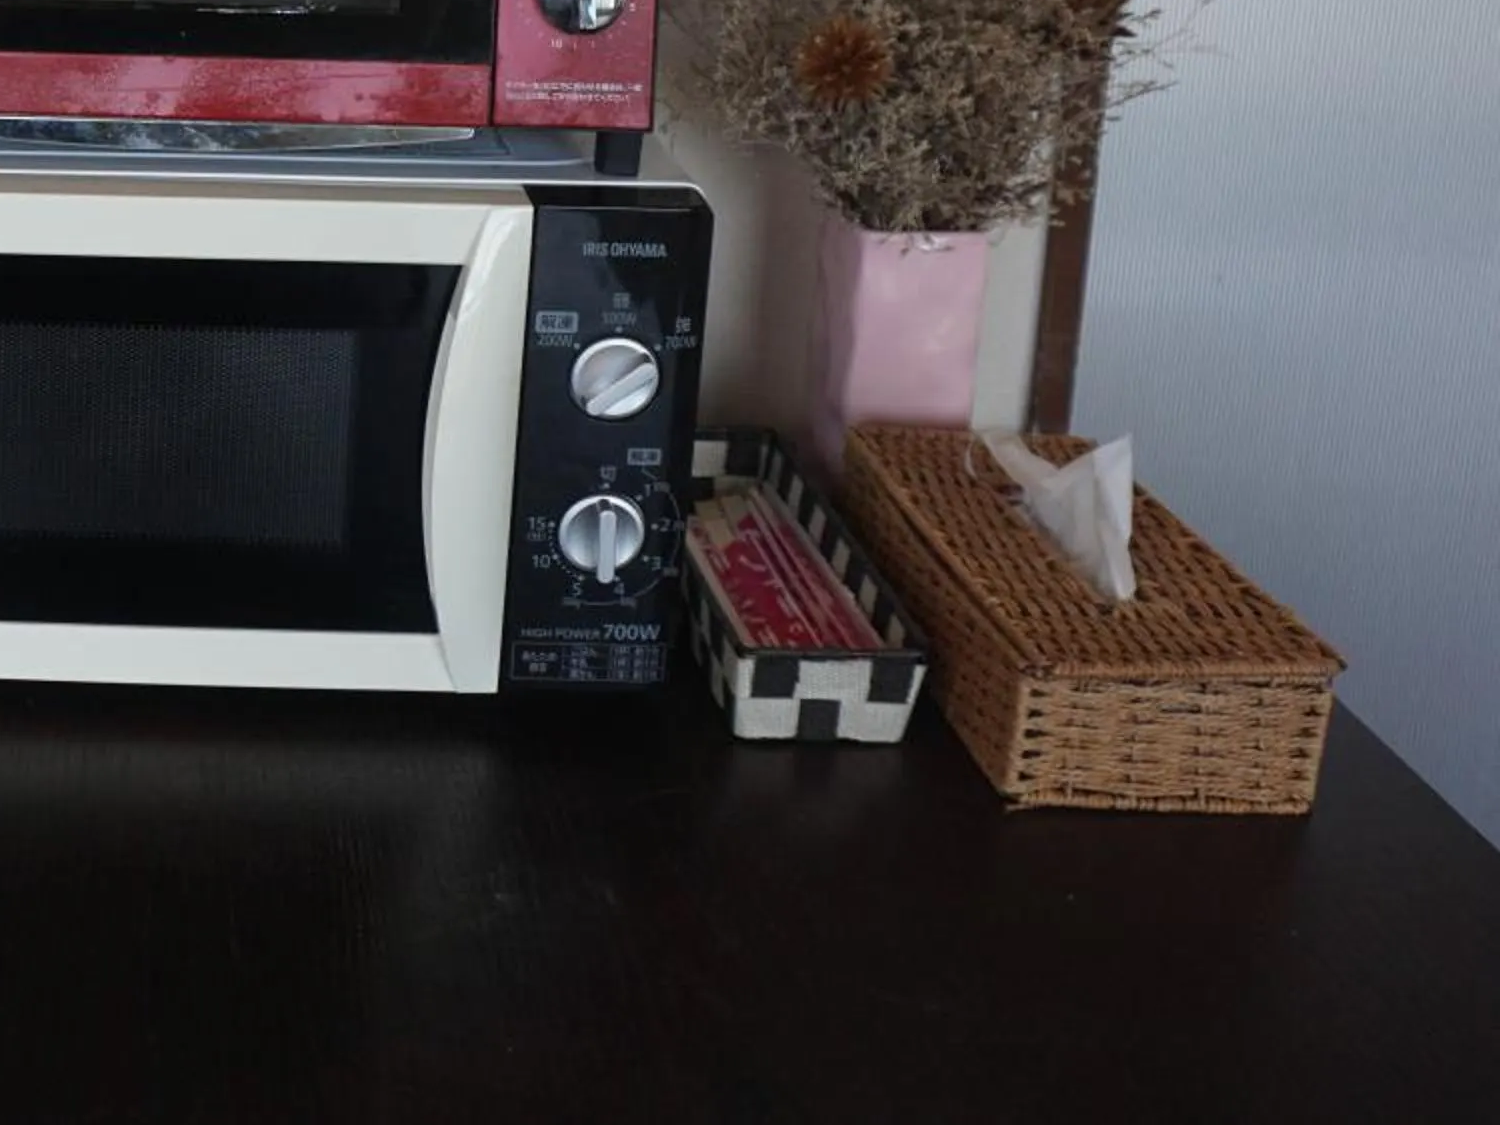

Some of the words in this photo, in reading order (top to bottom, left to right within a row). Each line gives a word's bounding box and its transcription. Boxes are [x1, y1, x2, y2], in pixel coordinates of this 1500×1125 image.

[582, 242, 609, 257] IRIS
[609, 242, 668, 258] OHYAMA
[527, 516, 547, 530] 15
[531, 555, 550, 569] 10
[572, 582, 582, 596] 5
[520, 628, 553, 638] HIGH
[554, 629, 601, 639] POWER
[603, 623, 661, 641] 700W
